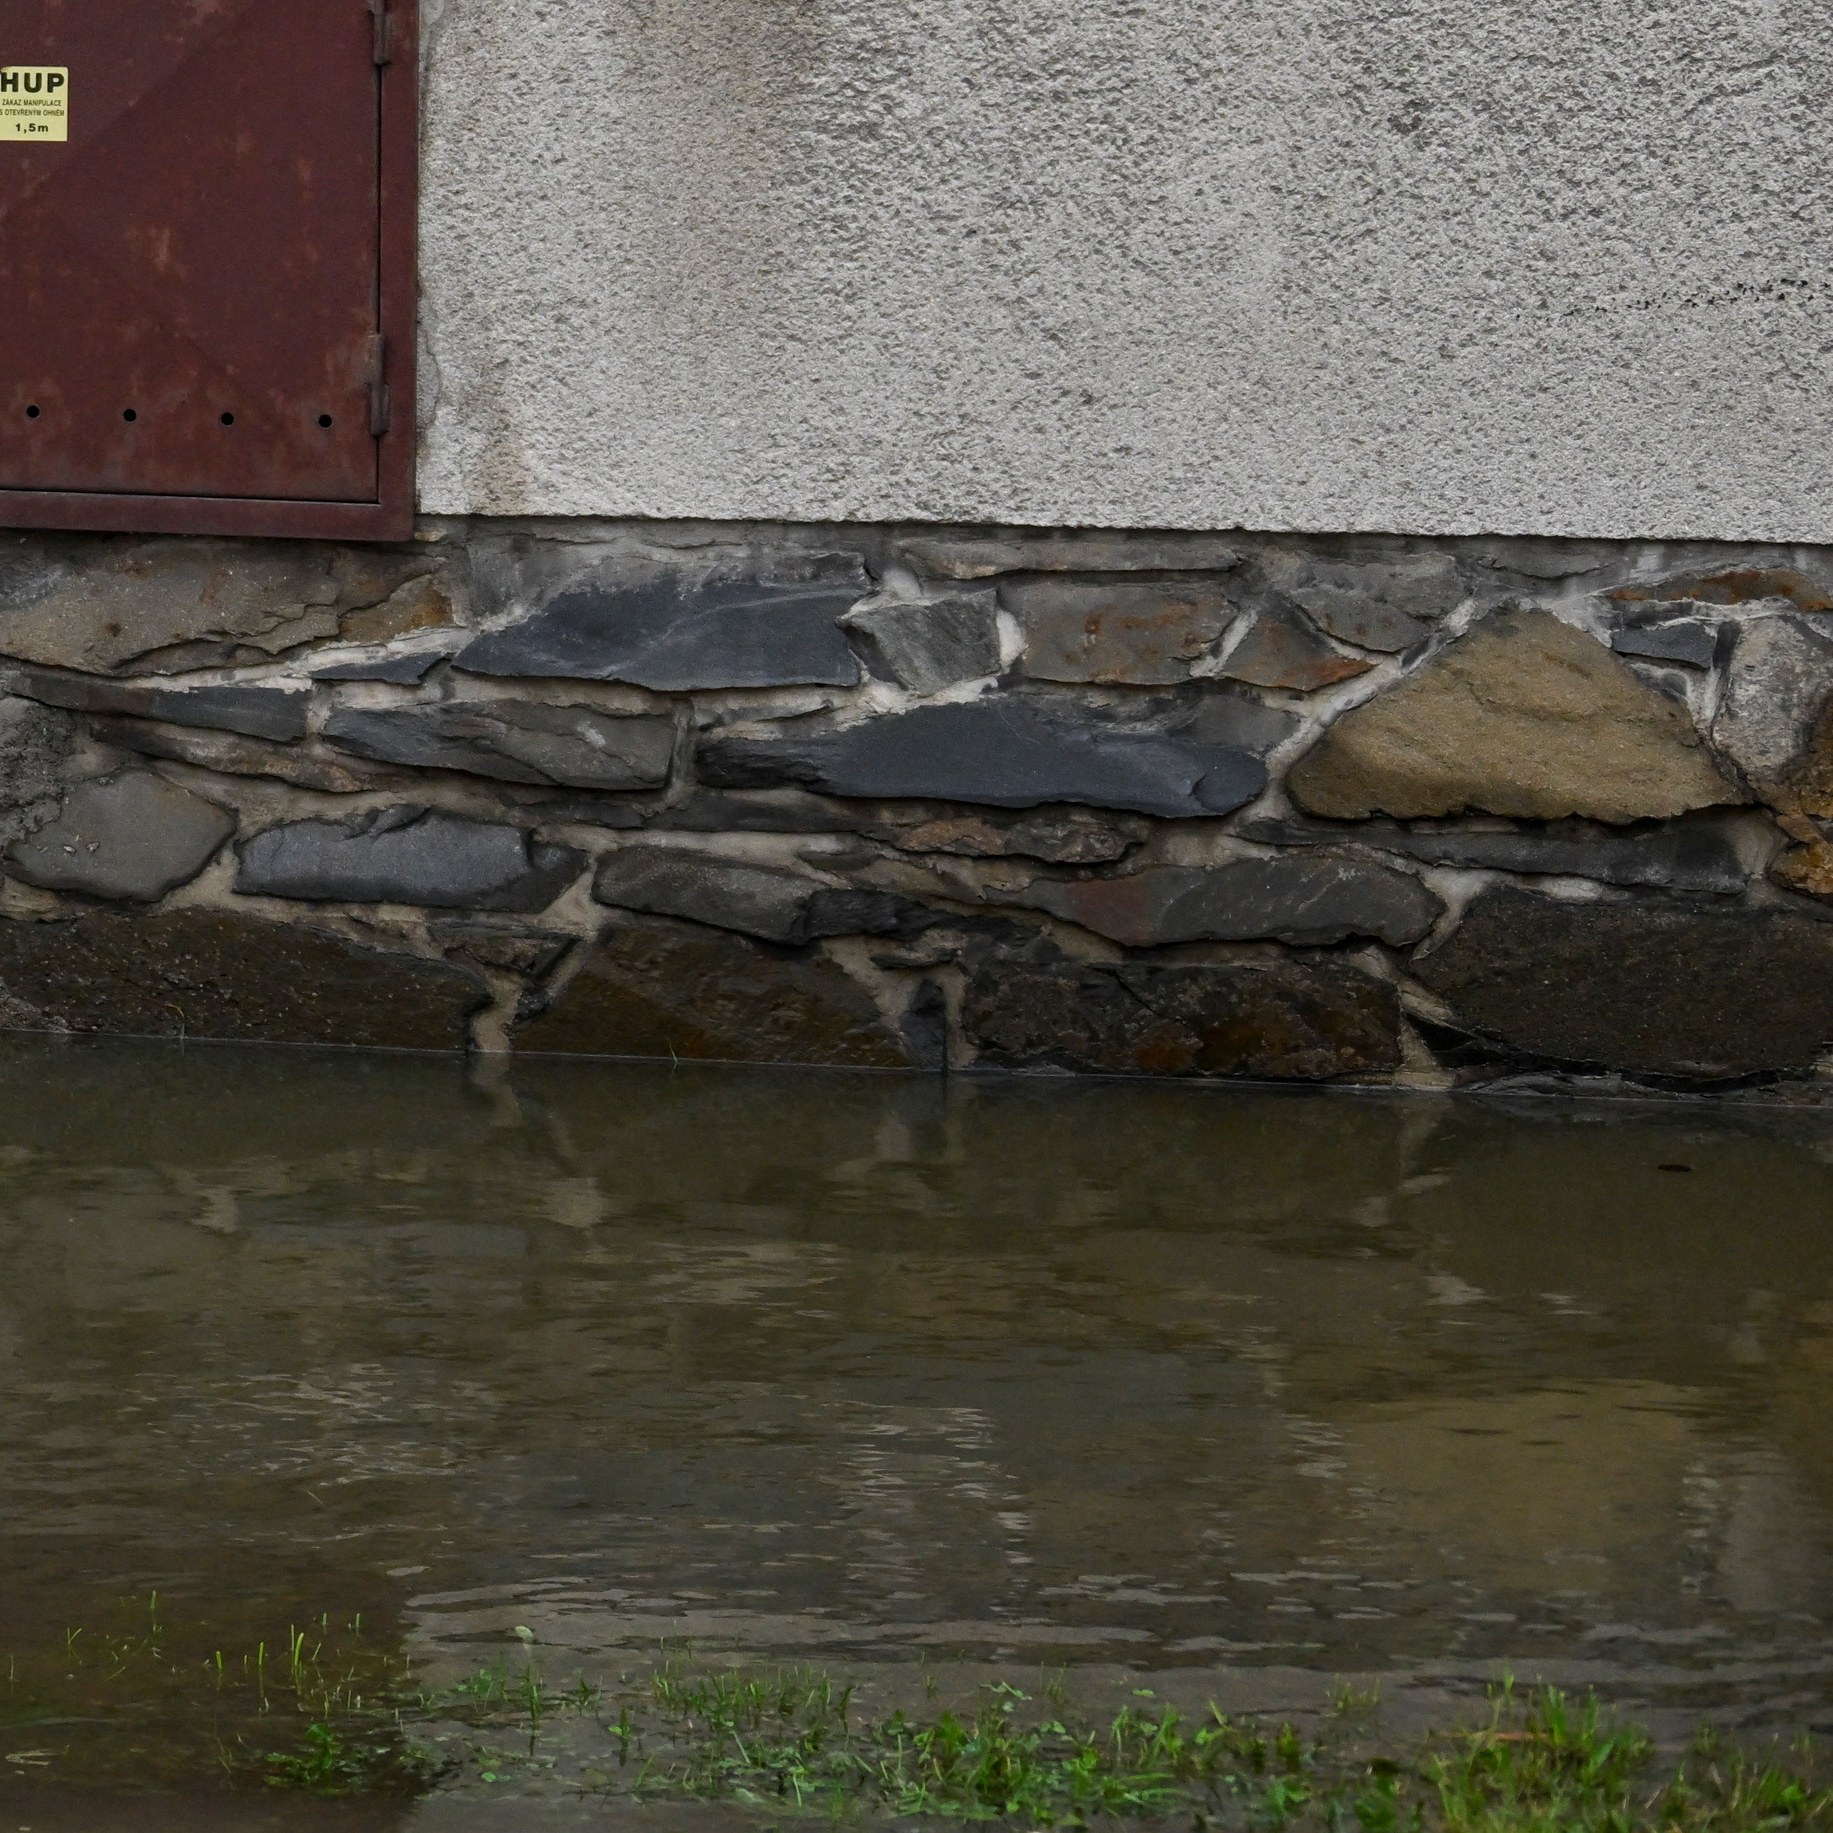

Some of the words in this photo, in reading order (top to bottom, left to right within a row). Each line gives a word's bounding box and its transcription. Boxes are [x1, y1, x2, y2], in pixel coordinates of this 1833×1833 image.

[0, 71, 65, 94] HUP
[2, 99, 22, 107] ZÁKAZ
[23, 99, 62, 107] MANIPULACE
